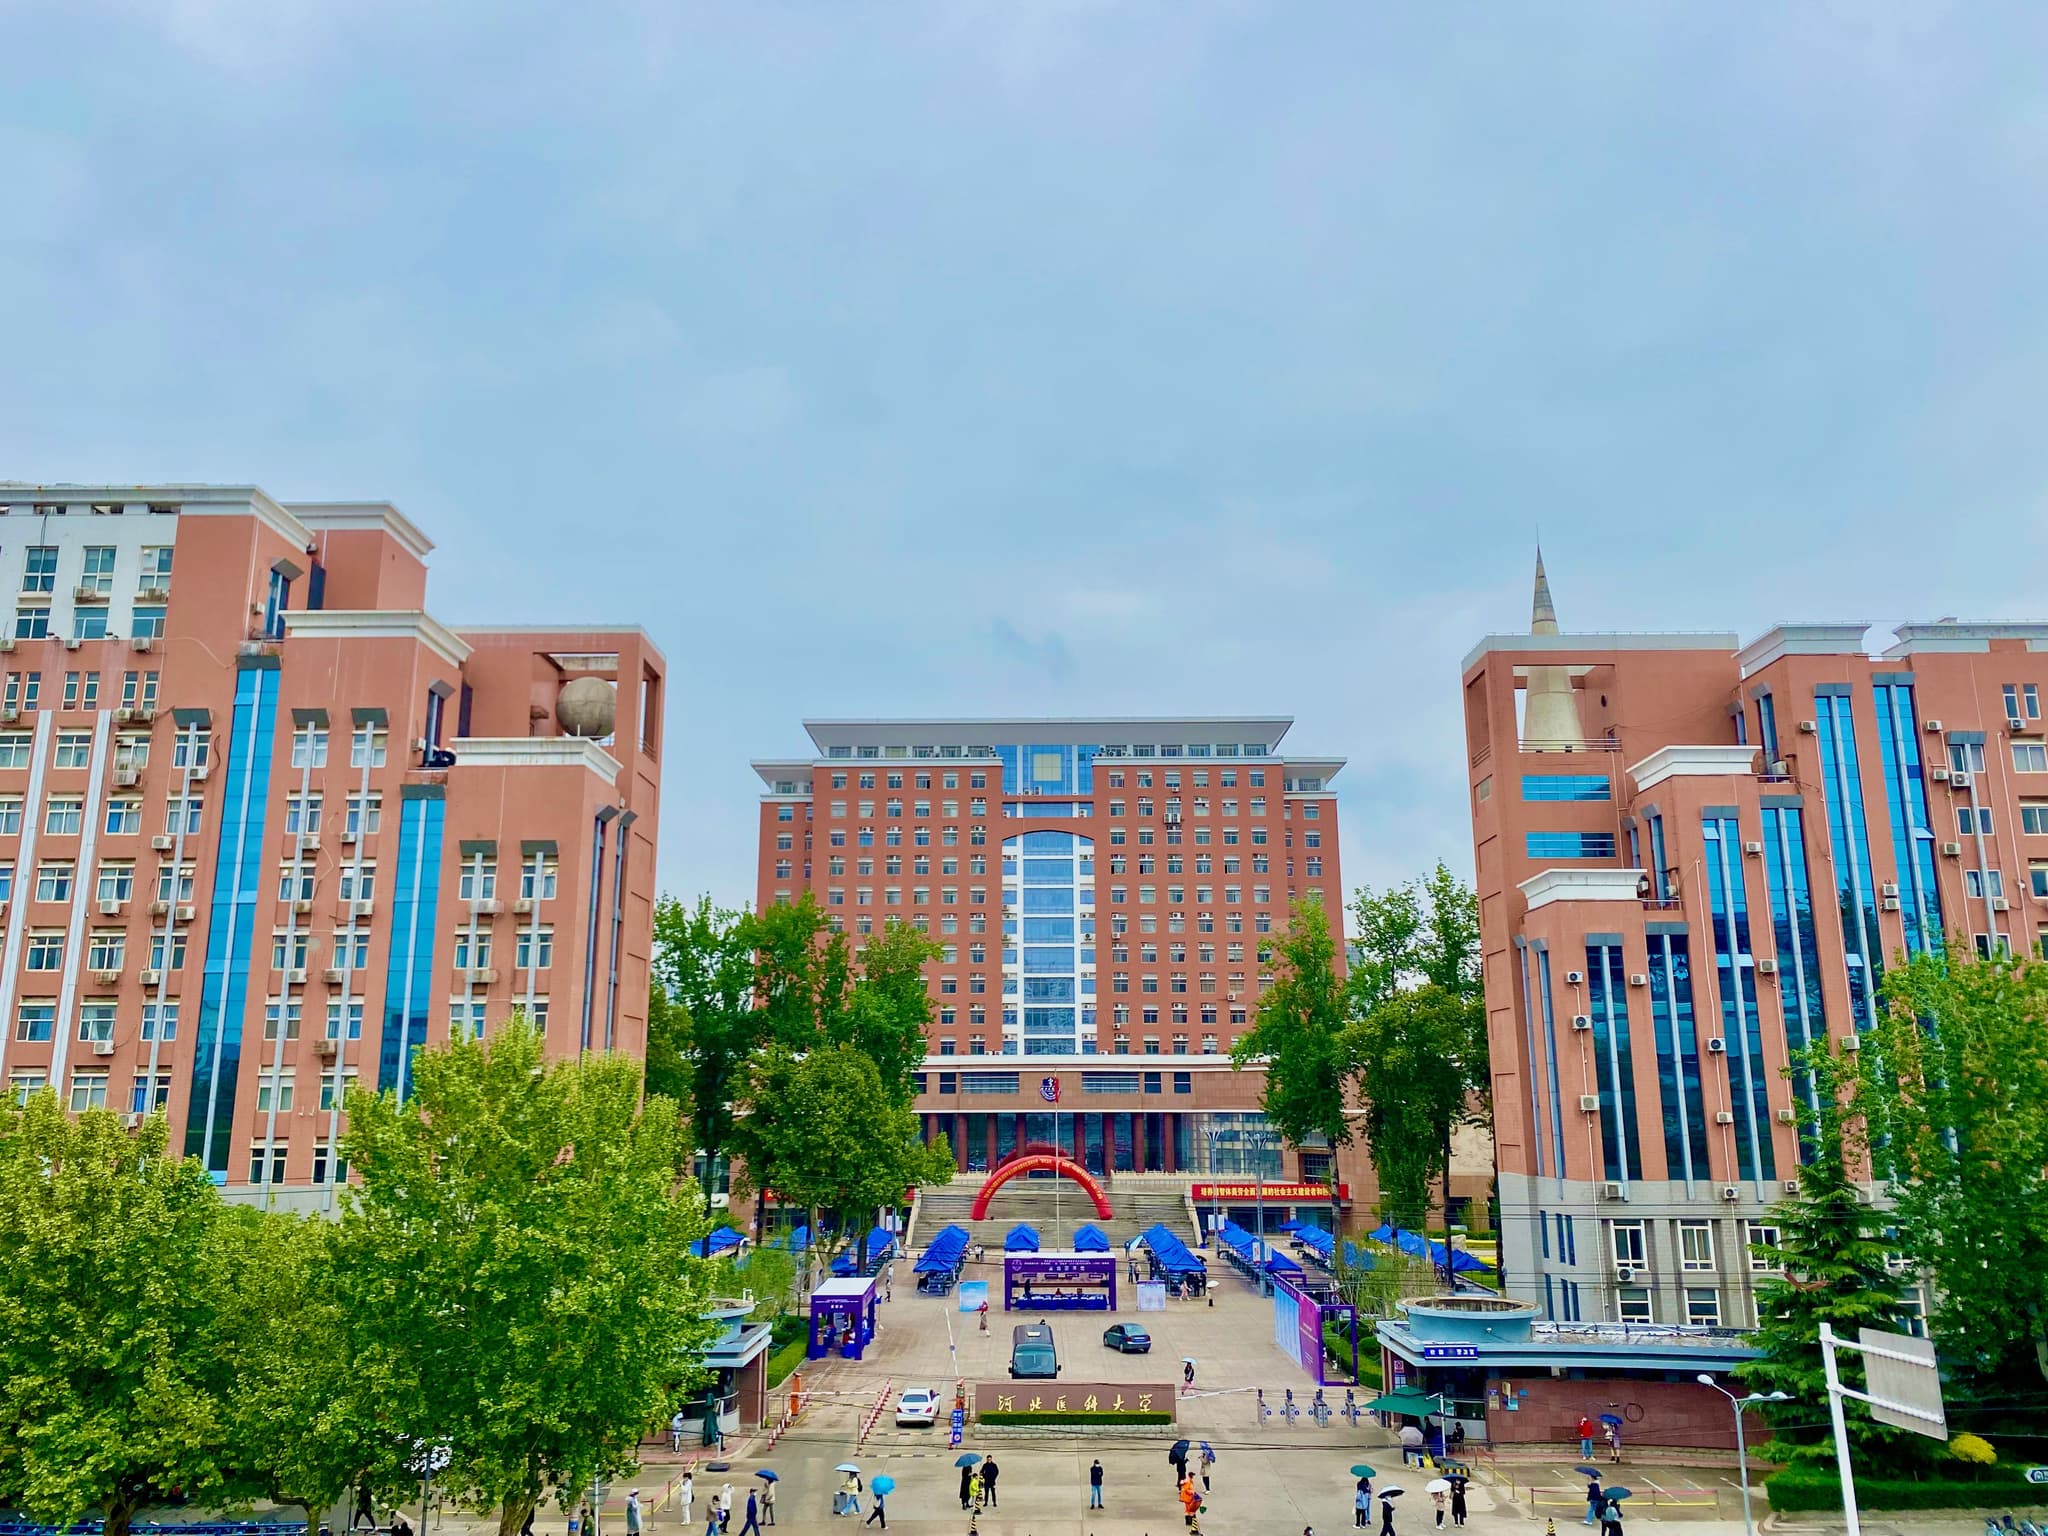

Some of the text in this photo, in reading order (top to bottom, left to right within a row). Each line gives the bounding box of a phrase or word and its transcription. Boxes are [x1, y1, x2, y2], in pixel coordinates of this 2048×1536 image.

[998, 1393, 1152, 1413] 河北医科大学
